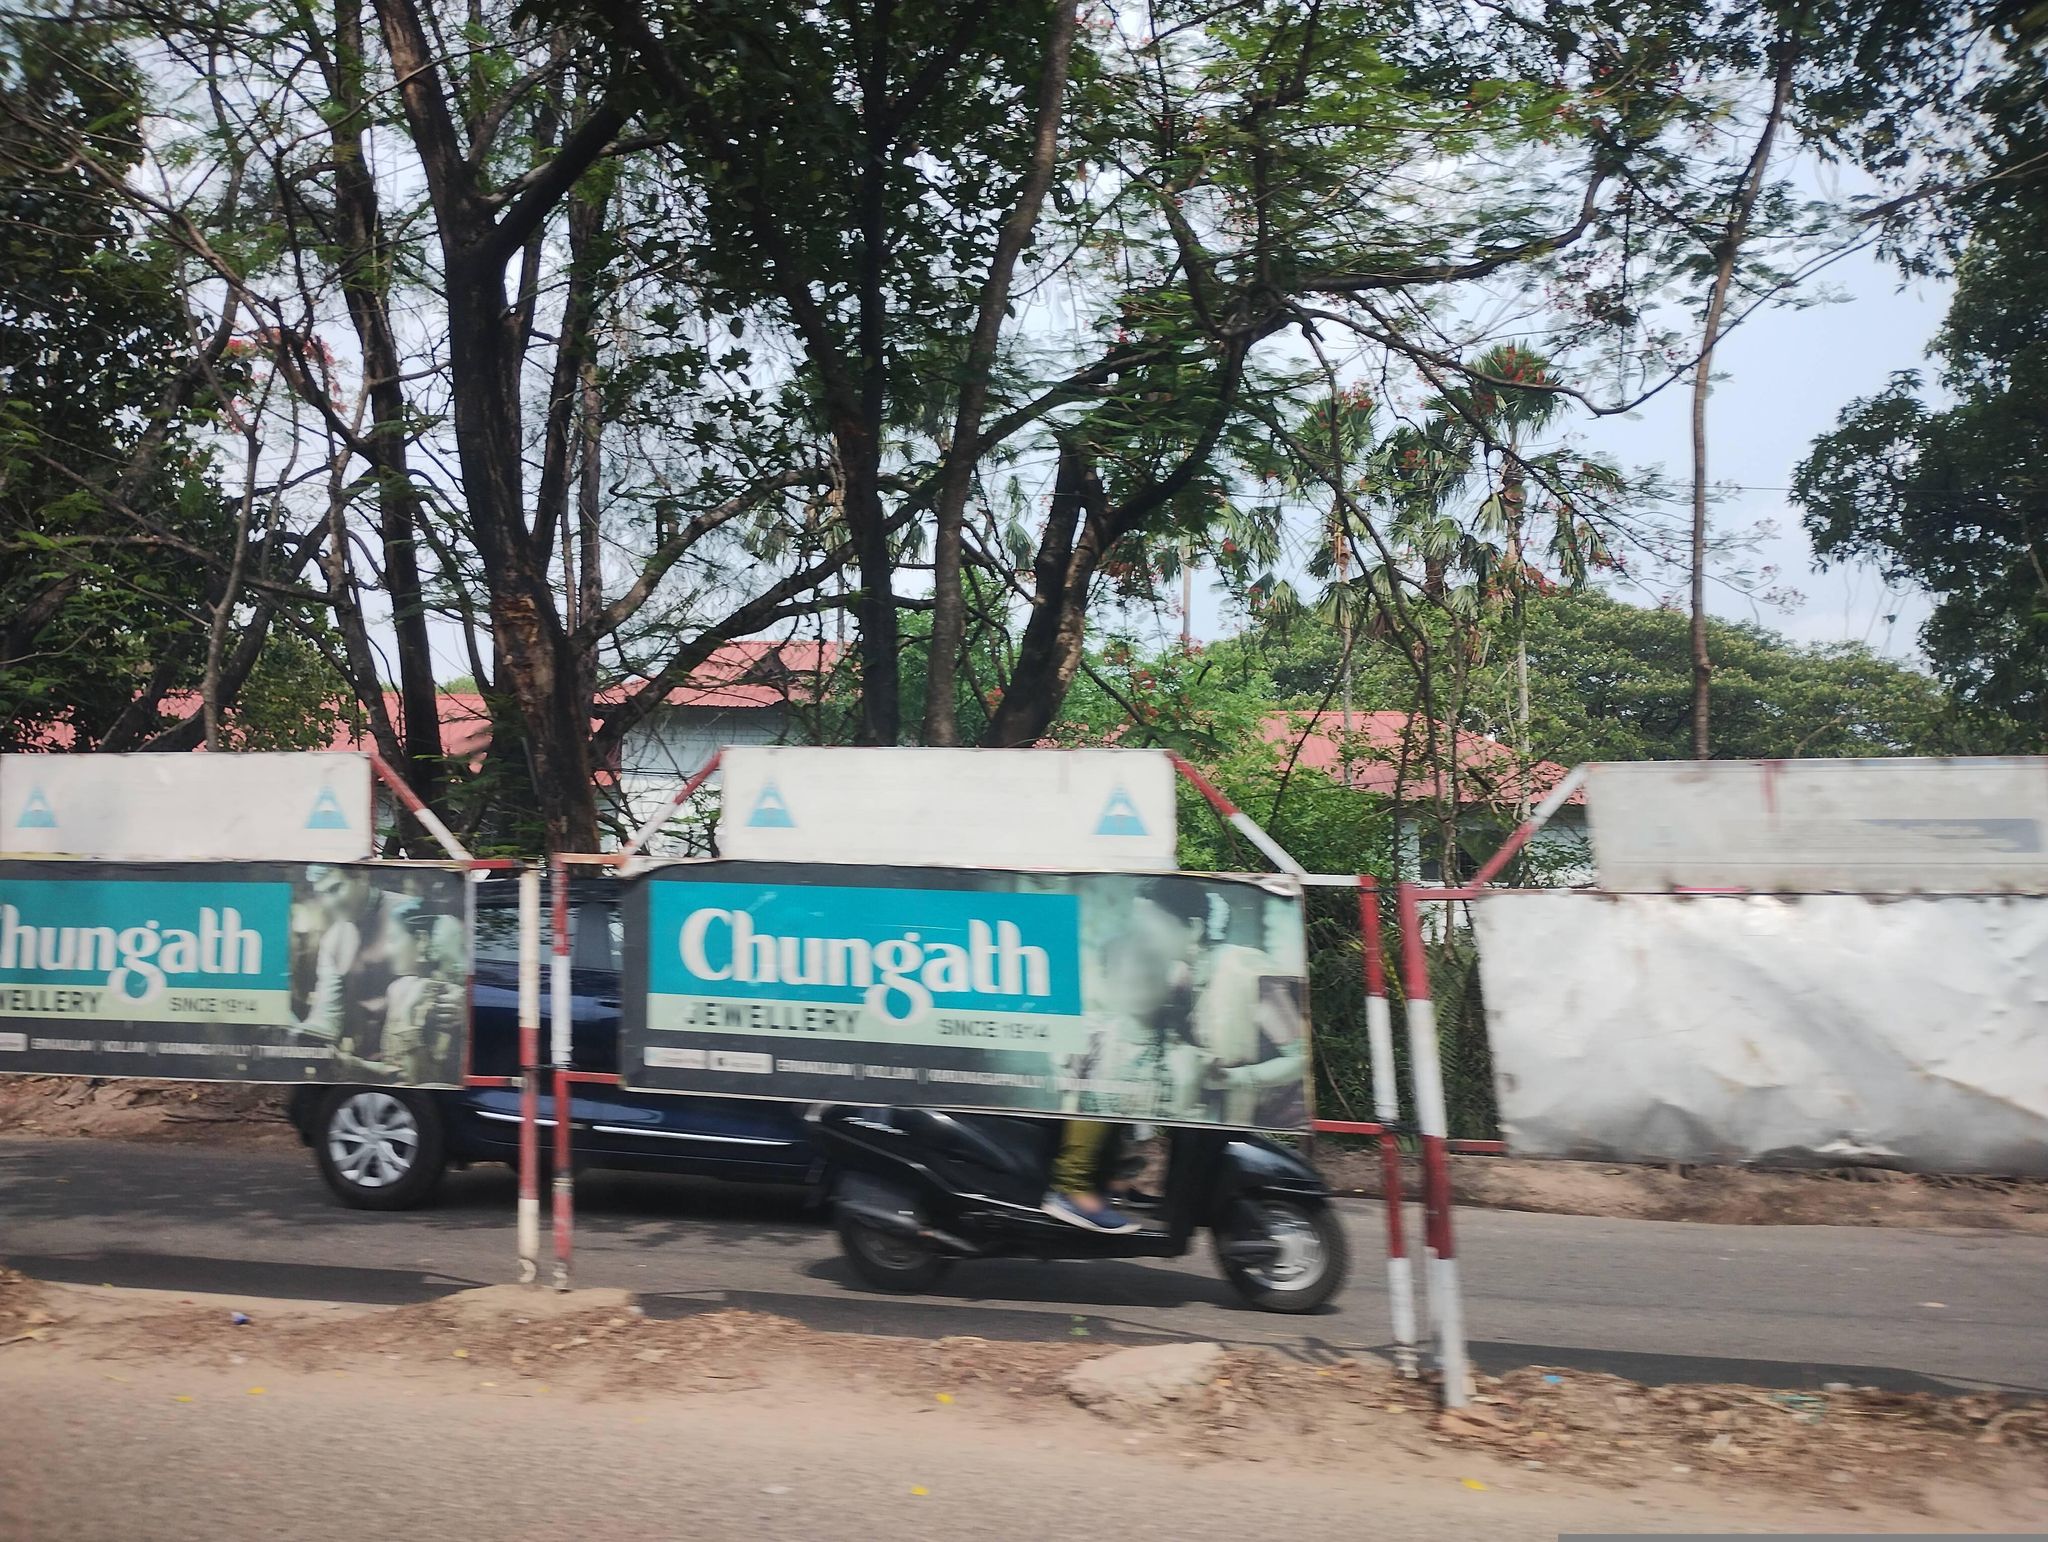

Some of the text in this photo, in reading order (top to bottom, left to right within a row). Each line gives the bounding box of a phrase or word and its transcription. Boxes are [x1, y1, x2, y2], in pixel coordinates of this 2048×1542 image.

[0, 904, 263, 1005] hungath
[678, 908, 1051, 1026] Chungath
[168, 997, 217, 1013] SINCE
[685, 1001, 861, 1034] JEWELLERY
[937, 1018, 1050, 1040] SINCE 1914
